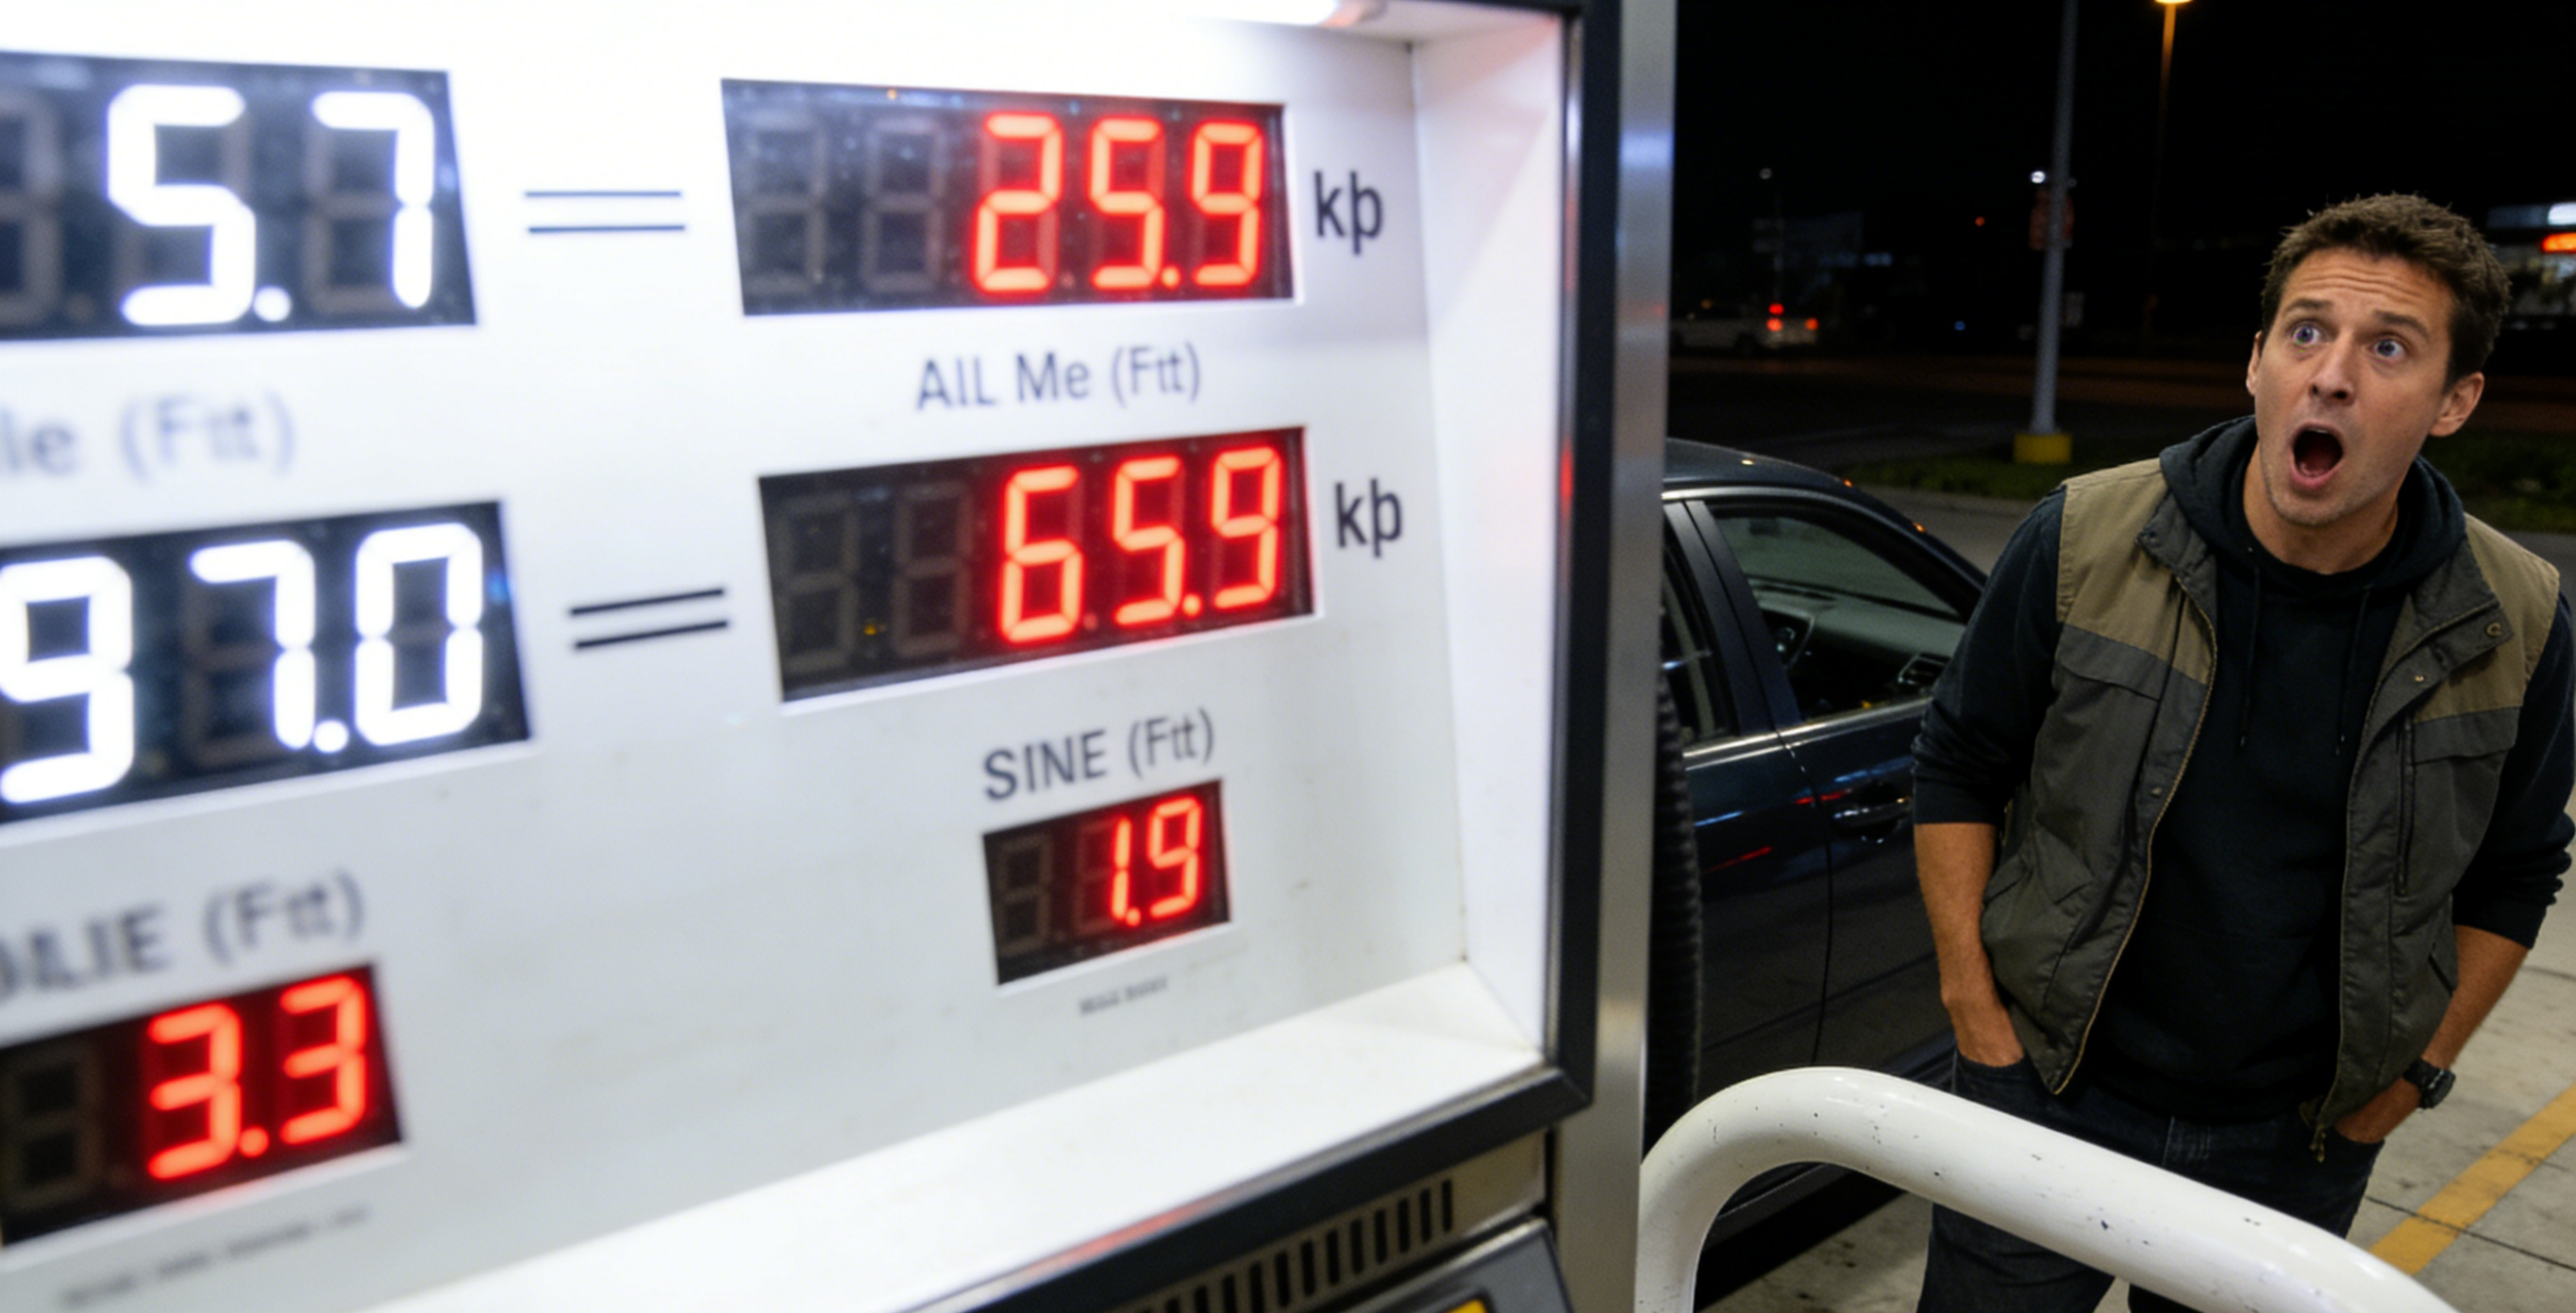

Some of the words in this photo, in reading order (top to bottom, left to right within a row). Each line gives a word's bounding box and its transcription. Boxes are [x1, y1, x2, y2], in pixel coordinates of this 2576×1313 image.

[108, 83, 434, 325] 5.7
[974, 111, 1265, 292] 25.9
[1016, 349, 1091, 403] Me
[1000, 447, 1283, 645] 65.9
[0, 523, 482, 804] 97.0
[984, 727, 1108, 801] SINE
[1112, 796, 1202, 926] 1.9
[147, 974, 367, 1181] 3.3
